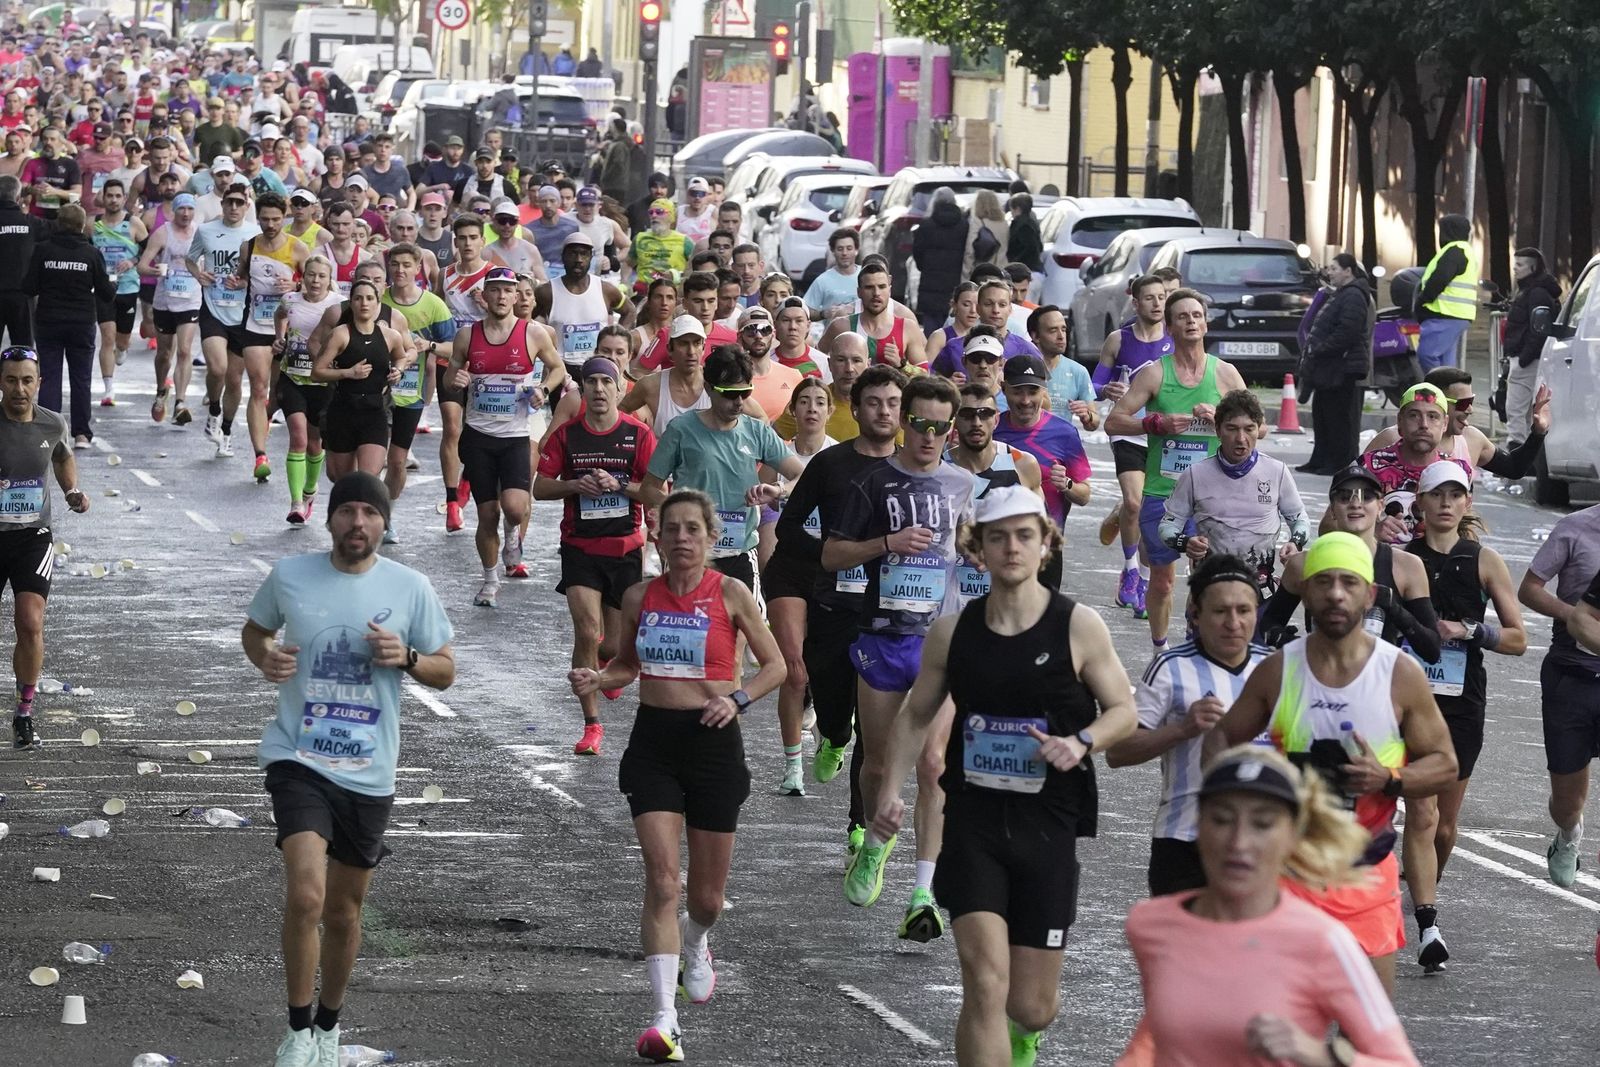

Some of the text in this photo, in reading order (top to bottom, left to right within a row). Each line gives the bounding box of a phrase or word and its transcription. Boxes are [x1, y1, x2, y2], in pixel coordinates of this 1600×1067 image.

[443, 7, 464, 18] 30
[0, 225, 29, 234] UNTEER
[44, 260, 88, 272] VOLUNTEER
[574, 342, 593, 350] ALEX
[1226, 342, 1253, 354] 4249
[294, 360, 313, 368] LUCIE
[487, 385, 511, 393] ZURICH
[478, 403, 511, 413] ANTOINE
[1178, 442, 1204, 450] ZURICH
[12, 479, 38, 489] ZURICH
[592, 497, 620, 509] TXABI
[903, 556, 940, 566] ZURICH
[903, 573, 923, 582] 7477
[967, 573, 984, 581] 6287
[890, 585, 932, 599] JAUME
[661, 616, 702, 627] ZURICH
[659, 634, 680, 645] 6203
[645, 647, 694, 663] MAGALI
[305, 682, 375, 700] SEVILLA
[331, 706, 371, 721] ZURICH
[312, 738, 362, 756] NACHO
[972, 753, 1037, 775] CHARLIE
